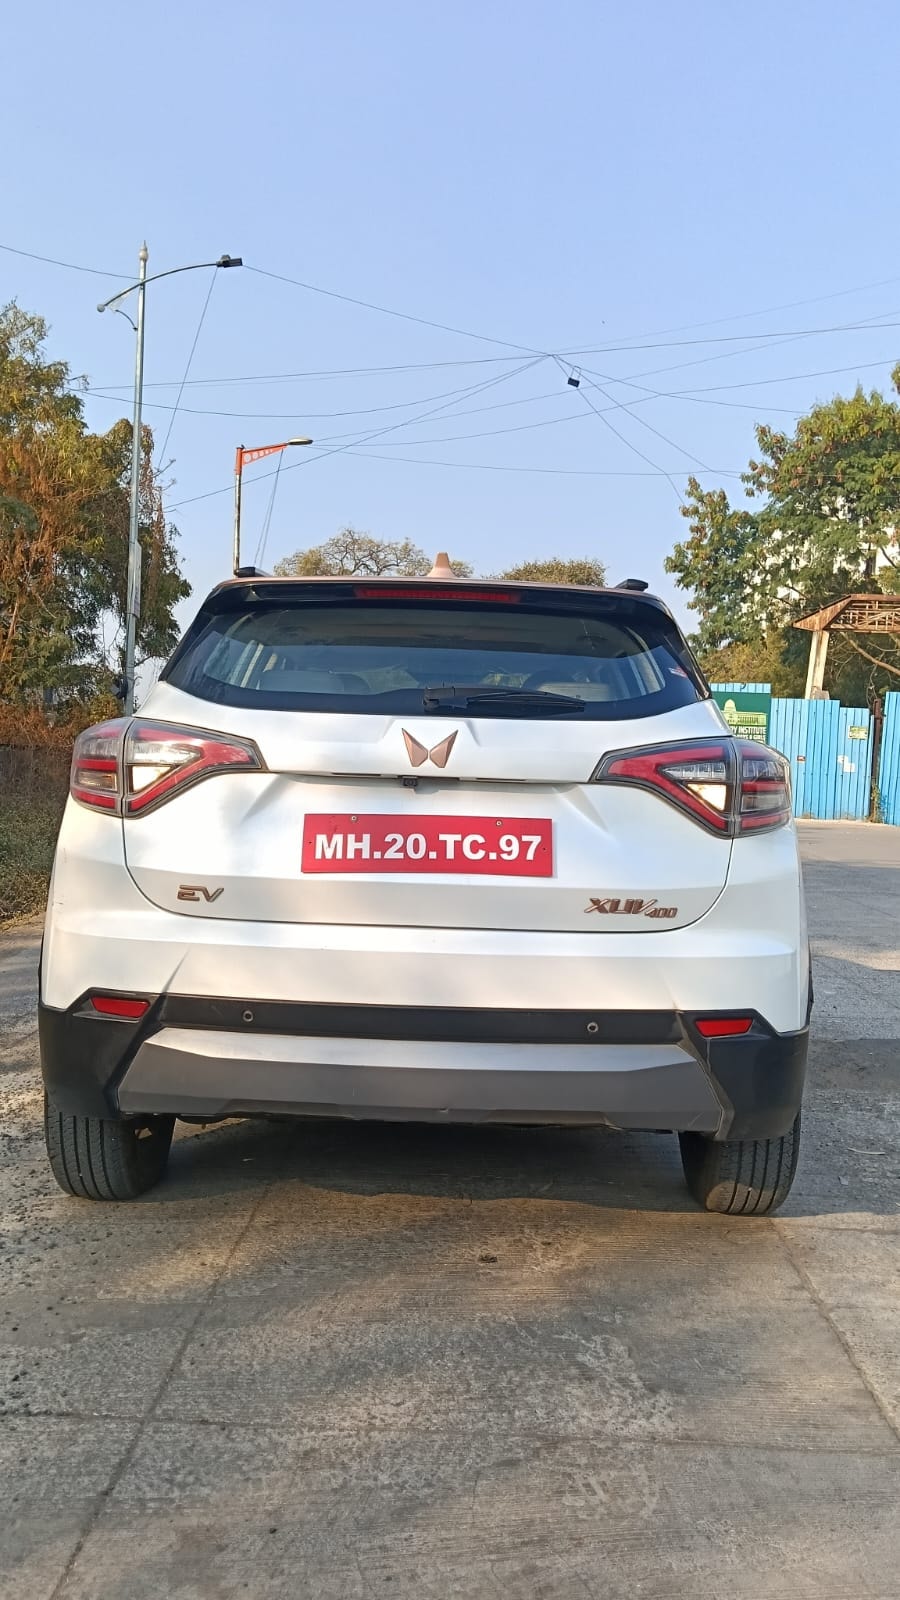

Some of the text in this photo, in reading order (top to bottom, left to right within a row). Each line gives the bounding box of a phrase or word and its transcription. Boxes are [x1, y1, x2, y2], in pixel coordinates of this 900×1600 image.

[739, 726, 767, 735] INSTITUTE
[314, 833, 541, 861] MH.20.TC.97
[177, 884, 225, 903] EV
